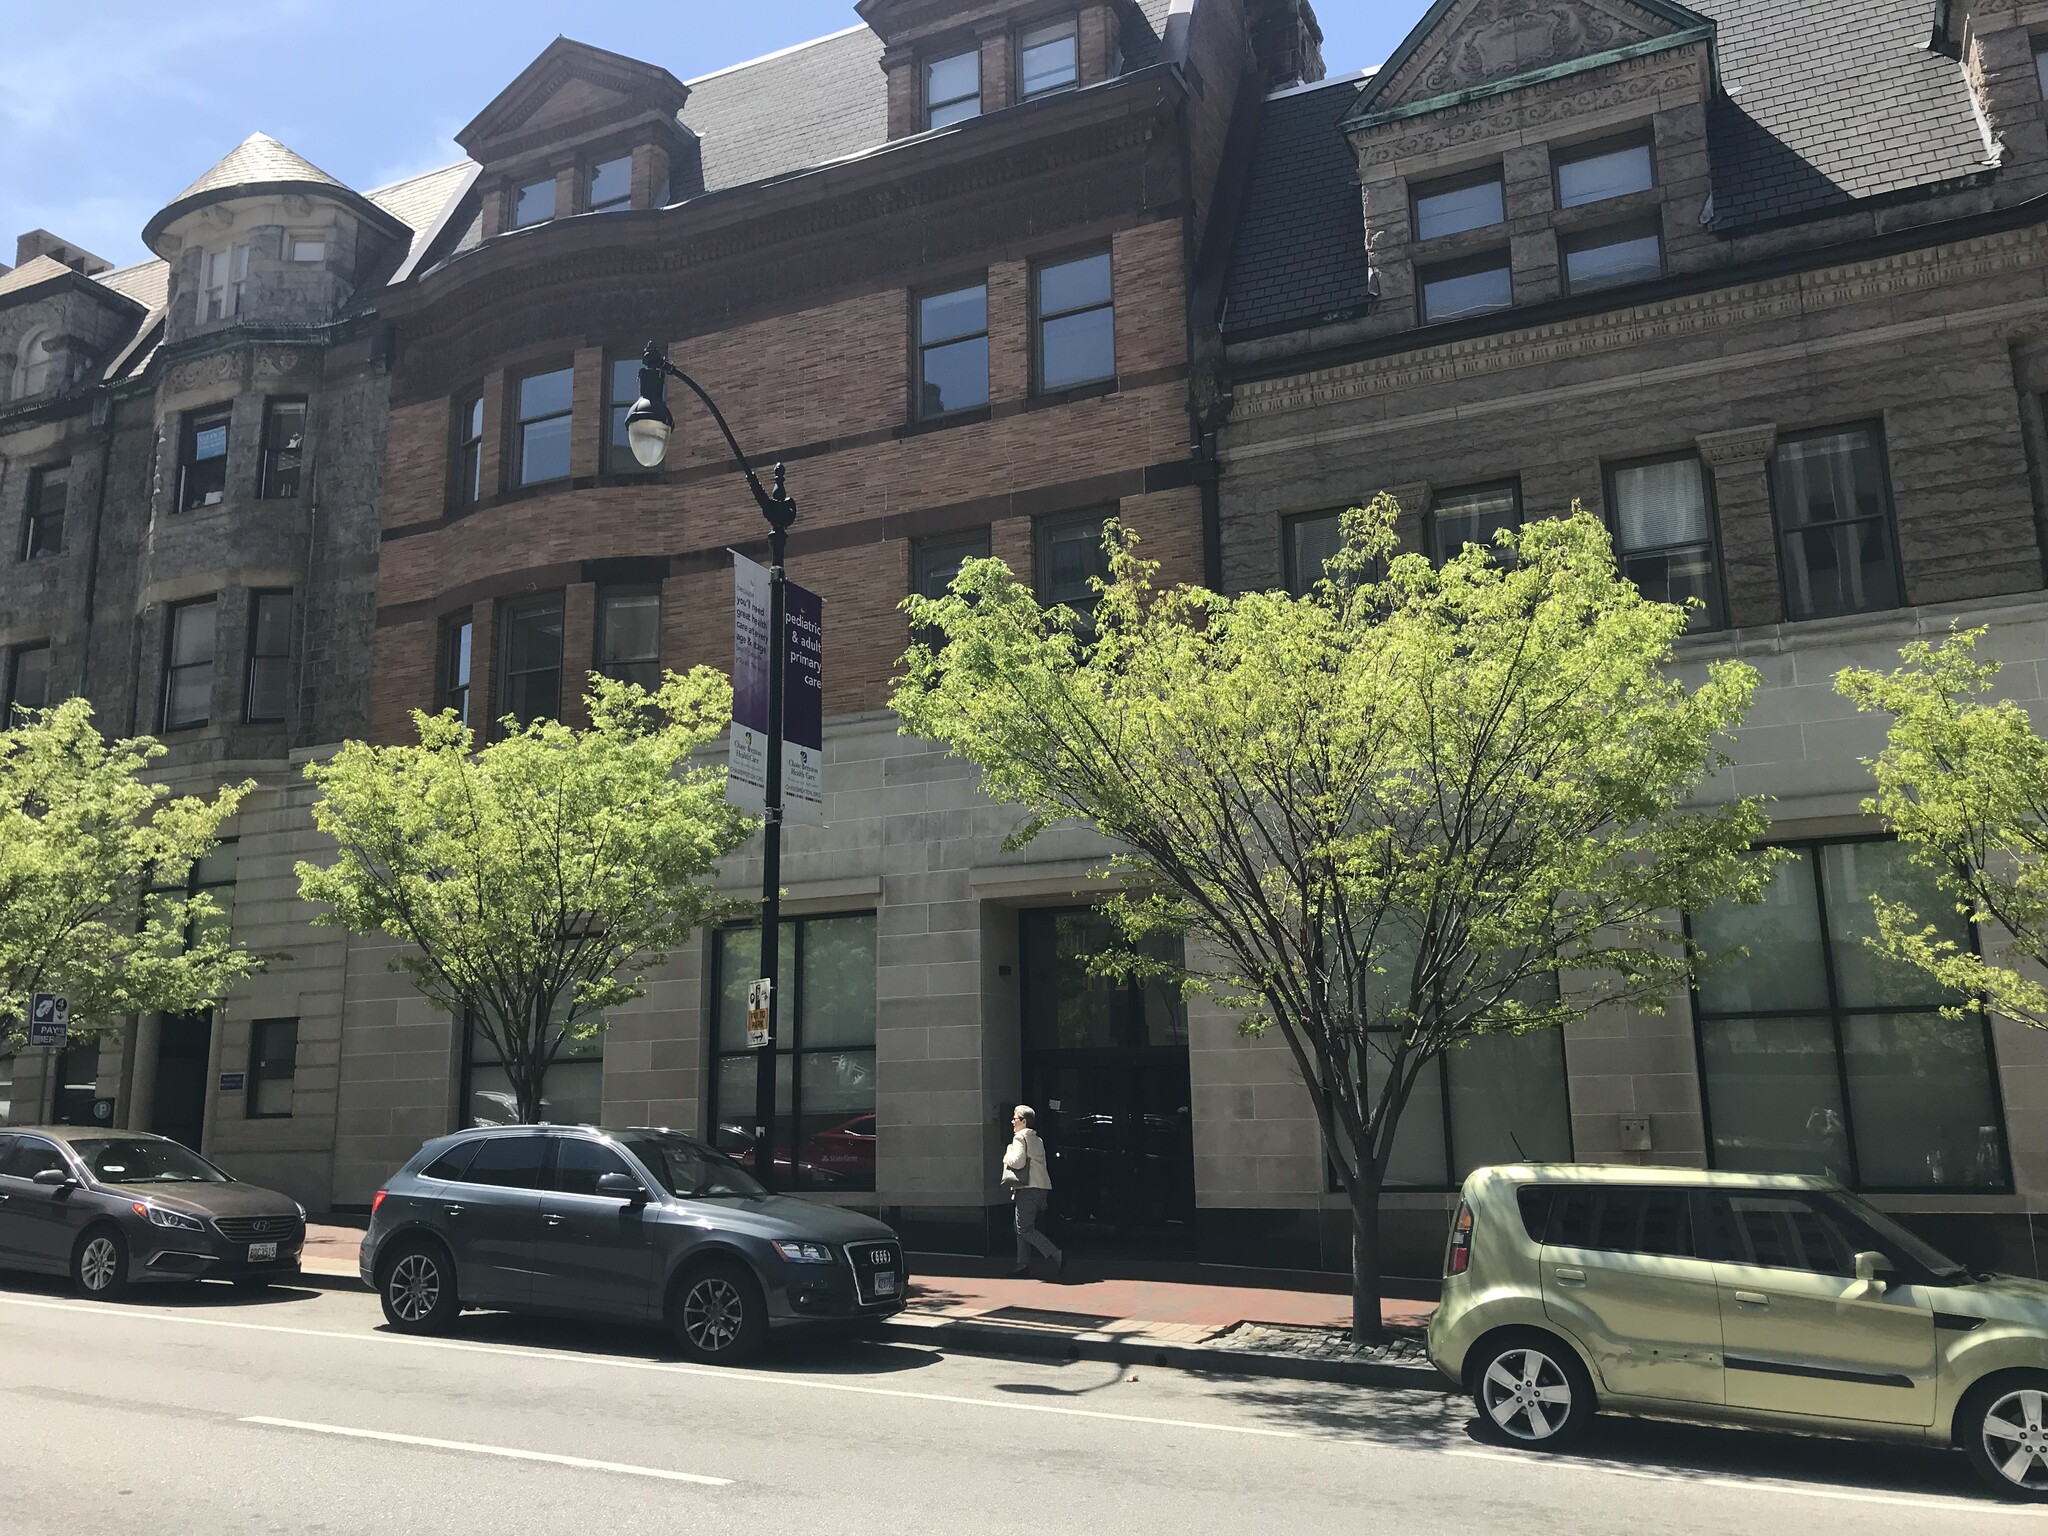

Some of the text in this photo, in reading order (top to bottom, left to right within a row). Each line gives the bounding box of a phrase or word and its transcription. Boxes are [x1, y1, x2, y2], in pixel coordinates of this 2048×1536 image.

[736, 596, 764, 615] you'll need
[736, 609, 768, 630] great health
[785, 612, 822, 636] pediatric
[736, 621, 748, 632] care
[755, 631, 768, 645] every
[736, 634, 747, 645] age
[747, 637, 753, 646] &
[791, 630, 822, 654] & adult
[790, 651, 822, 674] primary
[804, 675, 822, 689] care
[40, 1026, 58, 1034] PAY
[752, 1021, 763, 1029] PARK
